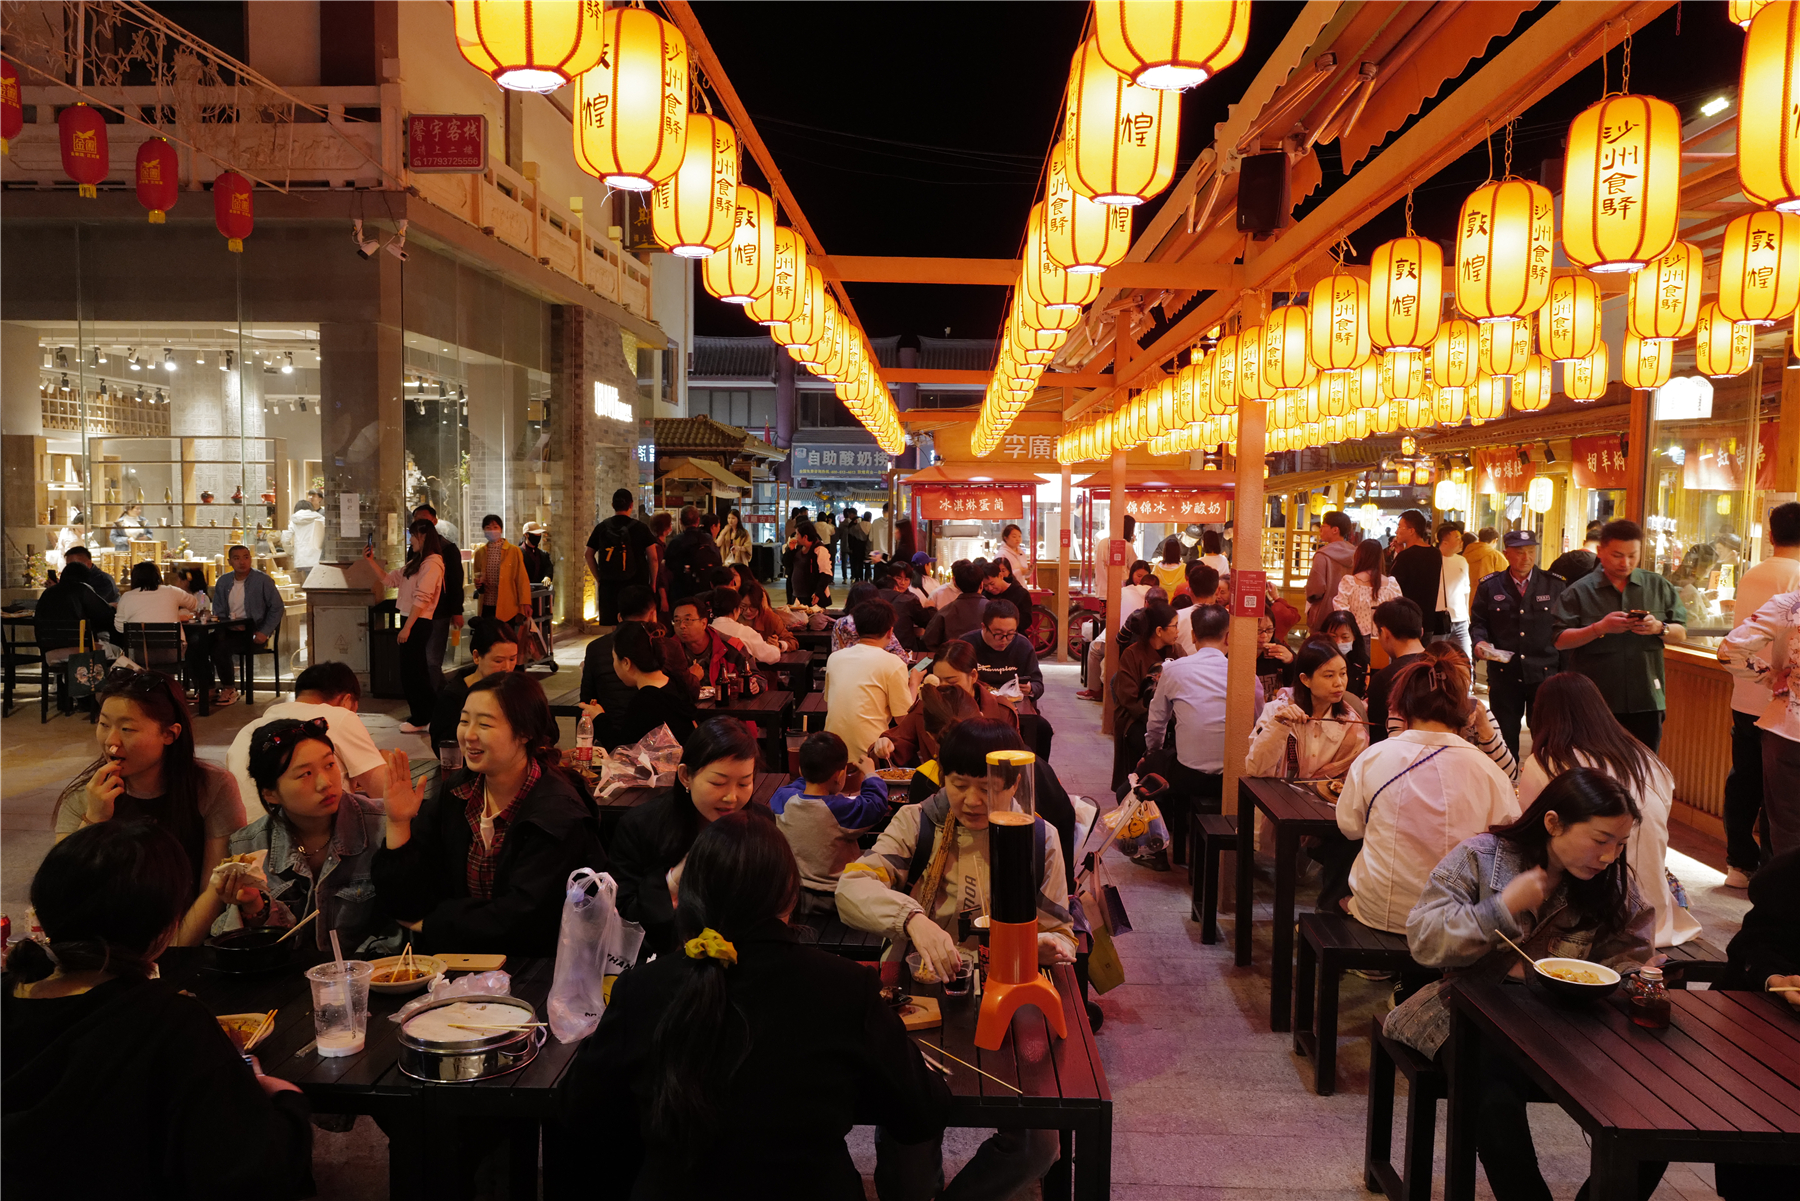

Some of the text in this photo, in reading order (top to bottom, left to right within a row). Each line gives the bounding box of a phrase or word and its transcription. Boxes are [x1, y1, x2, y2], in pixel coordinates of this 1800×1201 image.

[412, 118, 480, 142] 馨宇客栈
[417, 144, 474, 155] 请上二楼
[1463, 209, 1488, 283] 敦煌
[1747, 229, 1776, 290] 敦煌
[1392, 257, 1418, 317] 敦煌
[808, 450, 890, 467] 自助酸奶捞
[939, 498, 1004, 512] 冰淇淋蛋筒
